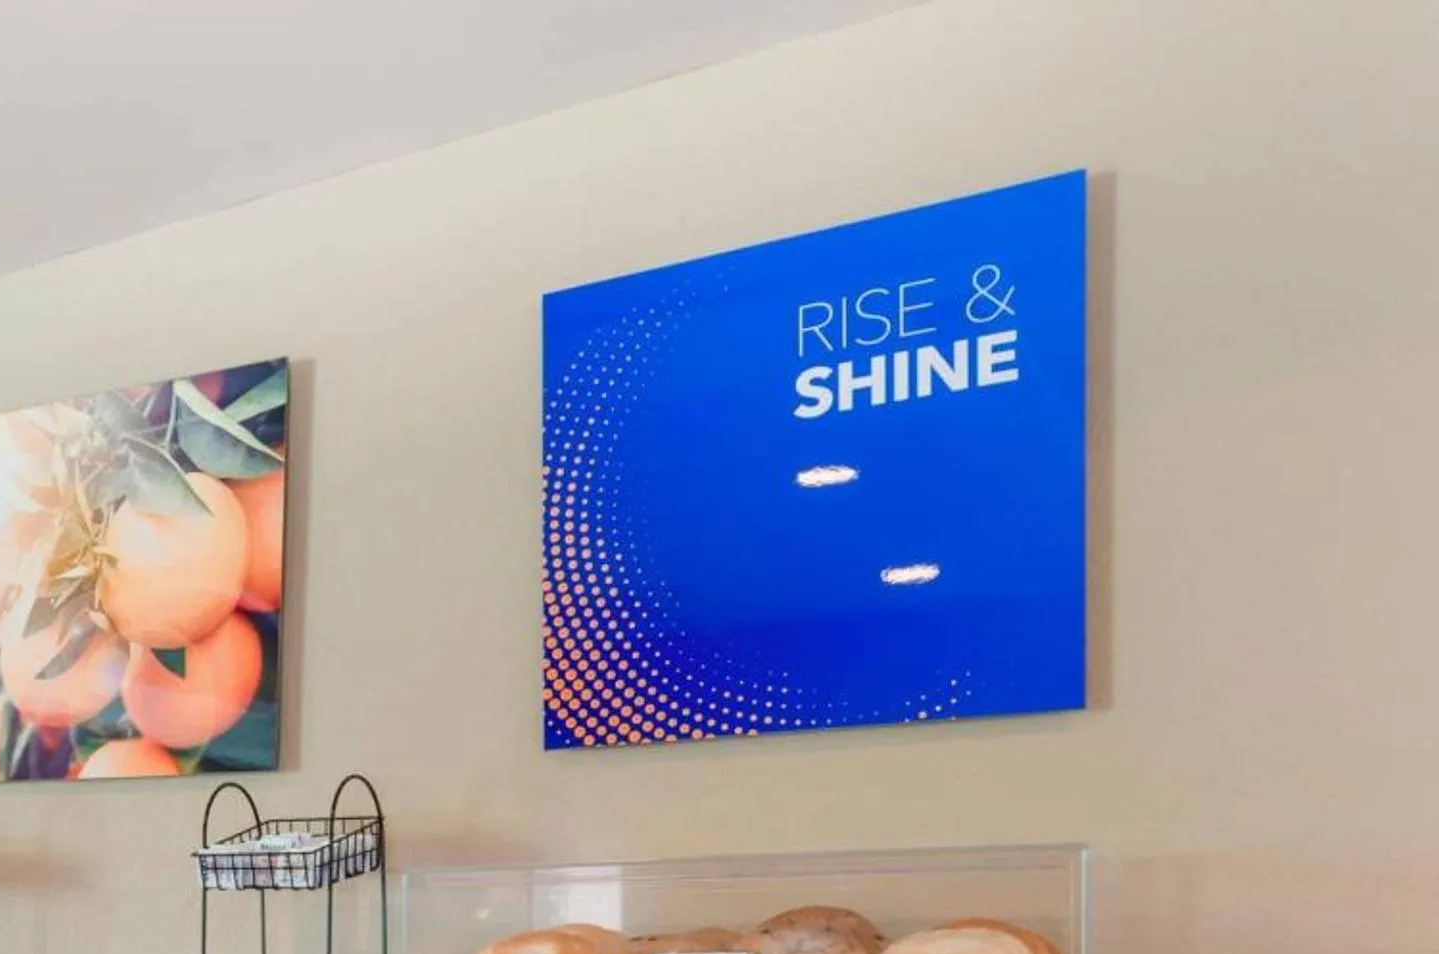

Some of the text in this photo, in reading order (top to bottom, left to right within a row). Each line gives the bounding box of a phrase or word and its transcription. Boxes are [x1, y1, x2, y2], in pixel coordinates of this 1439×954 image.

[798, 264, 1016, 357] RISE &
[793, 329, 1019, 419] SHINE
